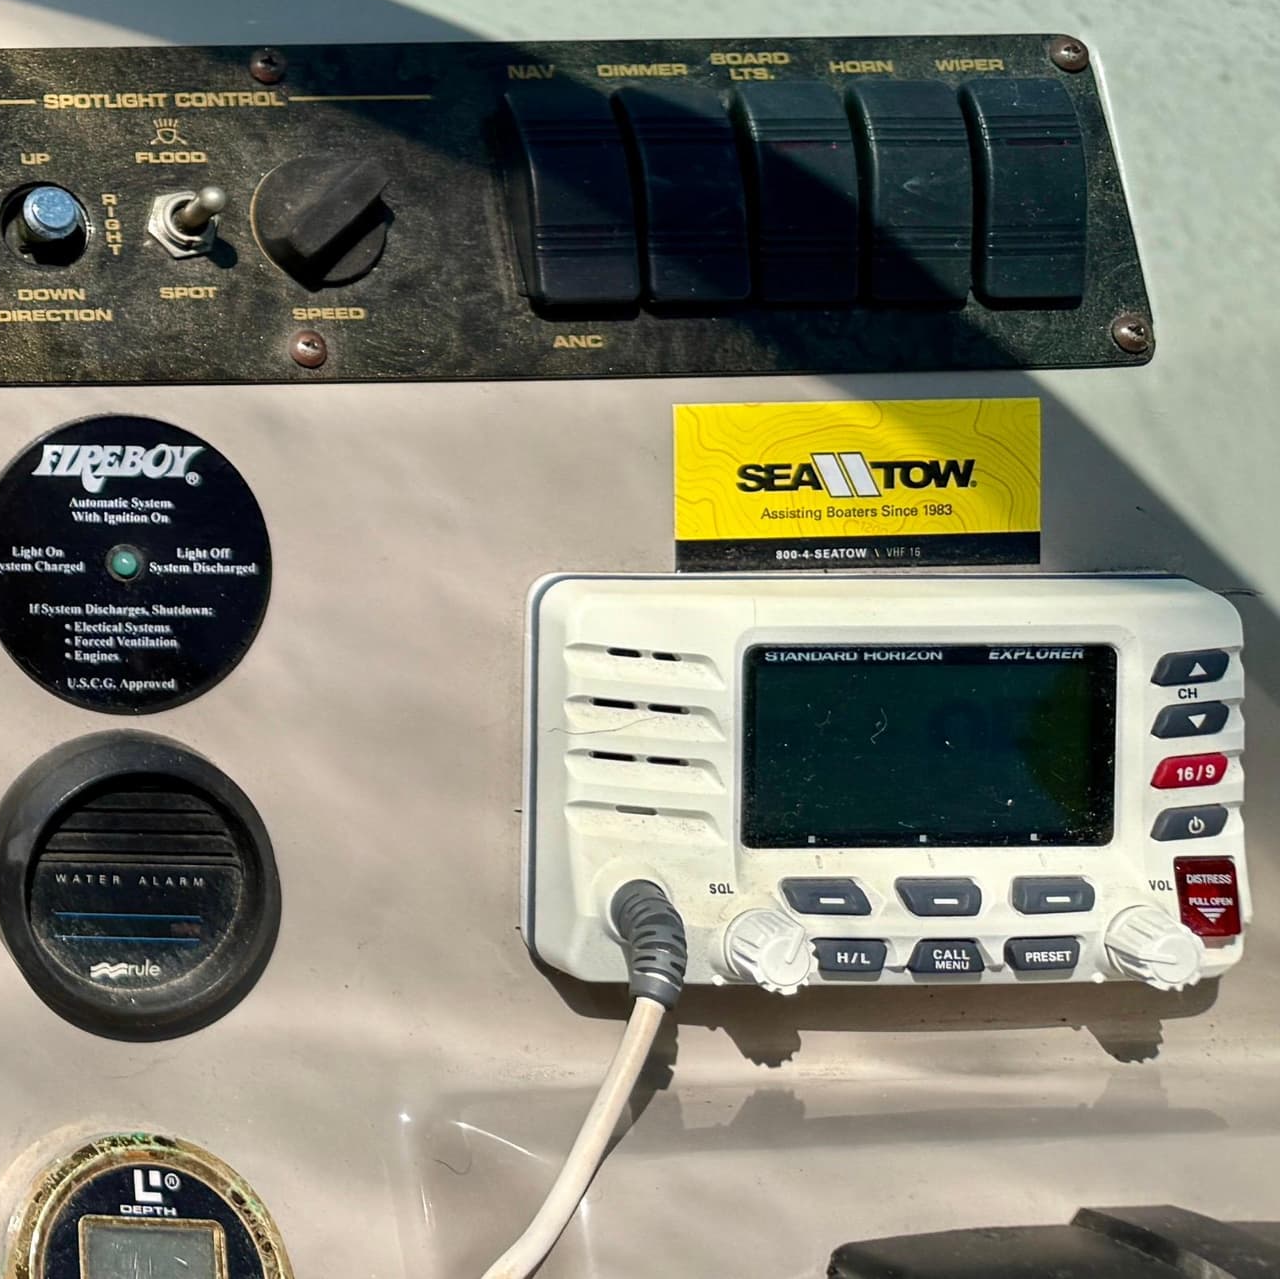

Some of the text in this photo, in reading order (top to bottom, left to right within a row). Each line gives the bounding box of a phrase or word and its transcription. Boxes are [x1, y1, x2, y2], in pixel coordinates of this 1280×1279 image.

[710, 52, 789, 65] BOARD
[597, 64, 687, 77] DIMMER
[830, 60, 893, 73] HORN
[935, 59, 1004, 72] WIPER
[508, 65, 554, 79] NAV
[730, 67, 774, 81] LTS.
[44, 92, 284, 108] SPOTLIGHT CONTROL
[21, 153, 50, 165] UP
[136, 152, 208, 163] FLOOD
[103, 194, 122, 255] RIGHT
[18, 289, 86, 301] DOWN
[160, 287, 216, 299] SPOT
[292, 308, 366, 320] SPEED
[553, 334, 603, 348] ANC
[32, 444, 204, 493] FIREBOY
[736, 460, 975, 492] SEA TOW
[70, 497, 174, 510] Automatic System
[72, 512, 170, 523] With Ignition On
[761, 504, 952, 521] Assisting Boaters Since 1983
[12, 547, 64, 557] Light On
[177, 548, 231, 559] Light Off
[776, 547, 920, 560] 800-4-SEATOW VHF 16
[35, 561, 85, 573] Charged
[149, 562, 258, 576] System Discharged
[30, 604, 214, 616] If System Discharges, Shutdown:
[74, 622, 171, 635] Electical Systems
[74, 636, 179, 647] Forced Ventilation
[74, 651, 120, 662] Engines
[765, 651, 942, 661] STANDARD HORIZON
[988, 648, 1084, 660] EXPLORER
[67, 678, 175, 690] U.S.C.G. Approved
[1178, 688, 1198, 699] CH
[1176, 765, 1216, 783] 16/9
[56, 875, 204, 887] WATER ALARM
[1149, 879, 1172, 891] VOL
[1186, 875, 1231, 884] DISTRESS
[709, 883, 733, 895] SQL
[1189, 897, 1233, 906] PULL OPEN
[837, 952, 870, 965] H/L
[933, 949, 970, 961] CALL
[1025, 951, 1072, 963] PRESET
[128, 960, 160, 976] rule
[936, 960, 970, 971] MENU
[120, 1205, 176, 1216] DEPTH
